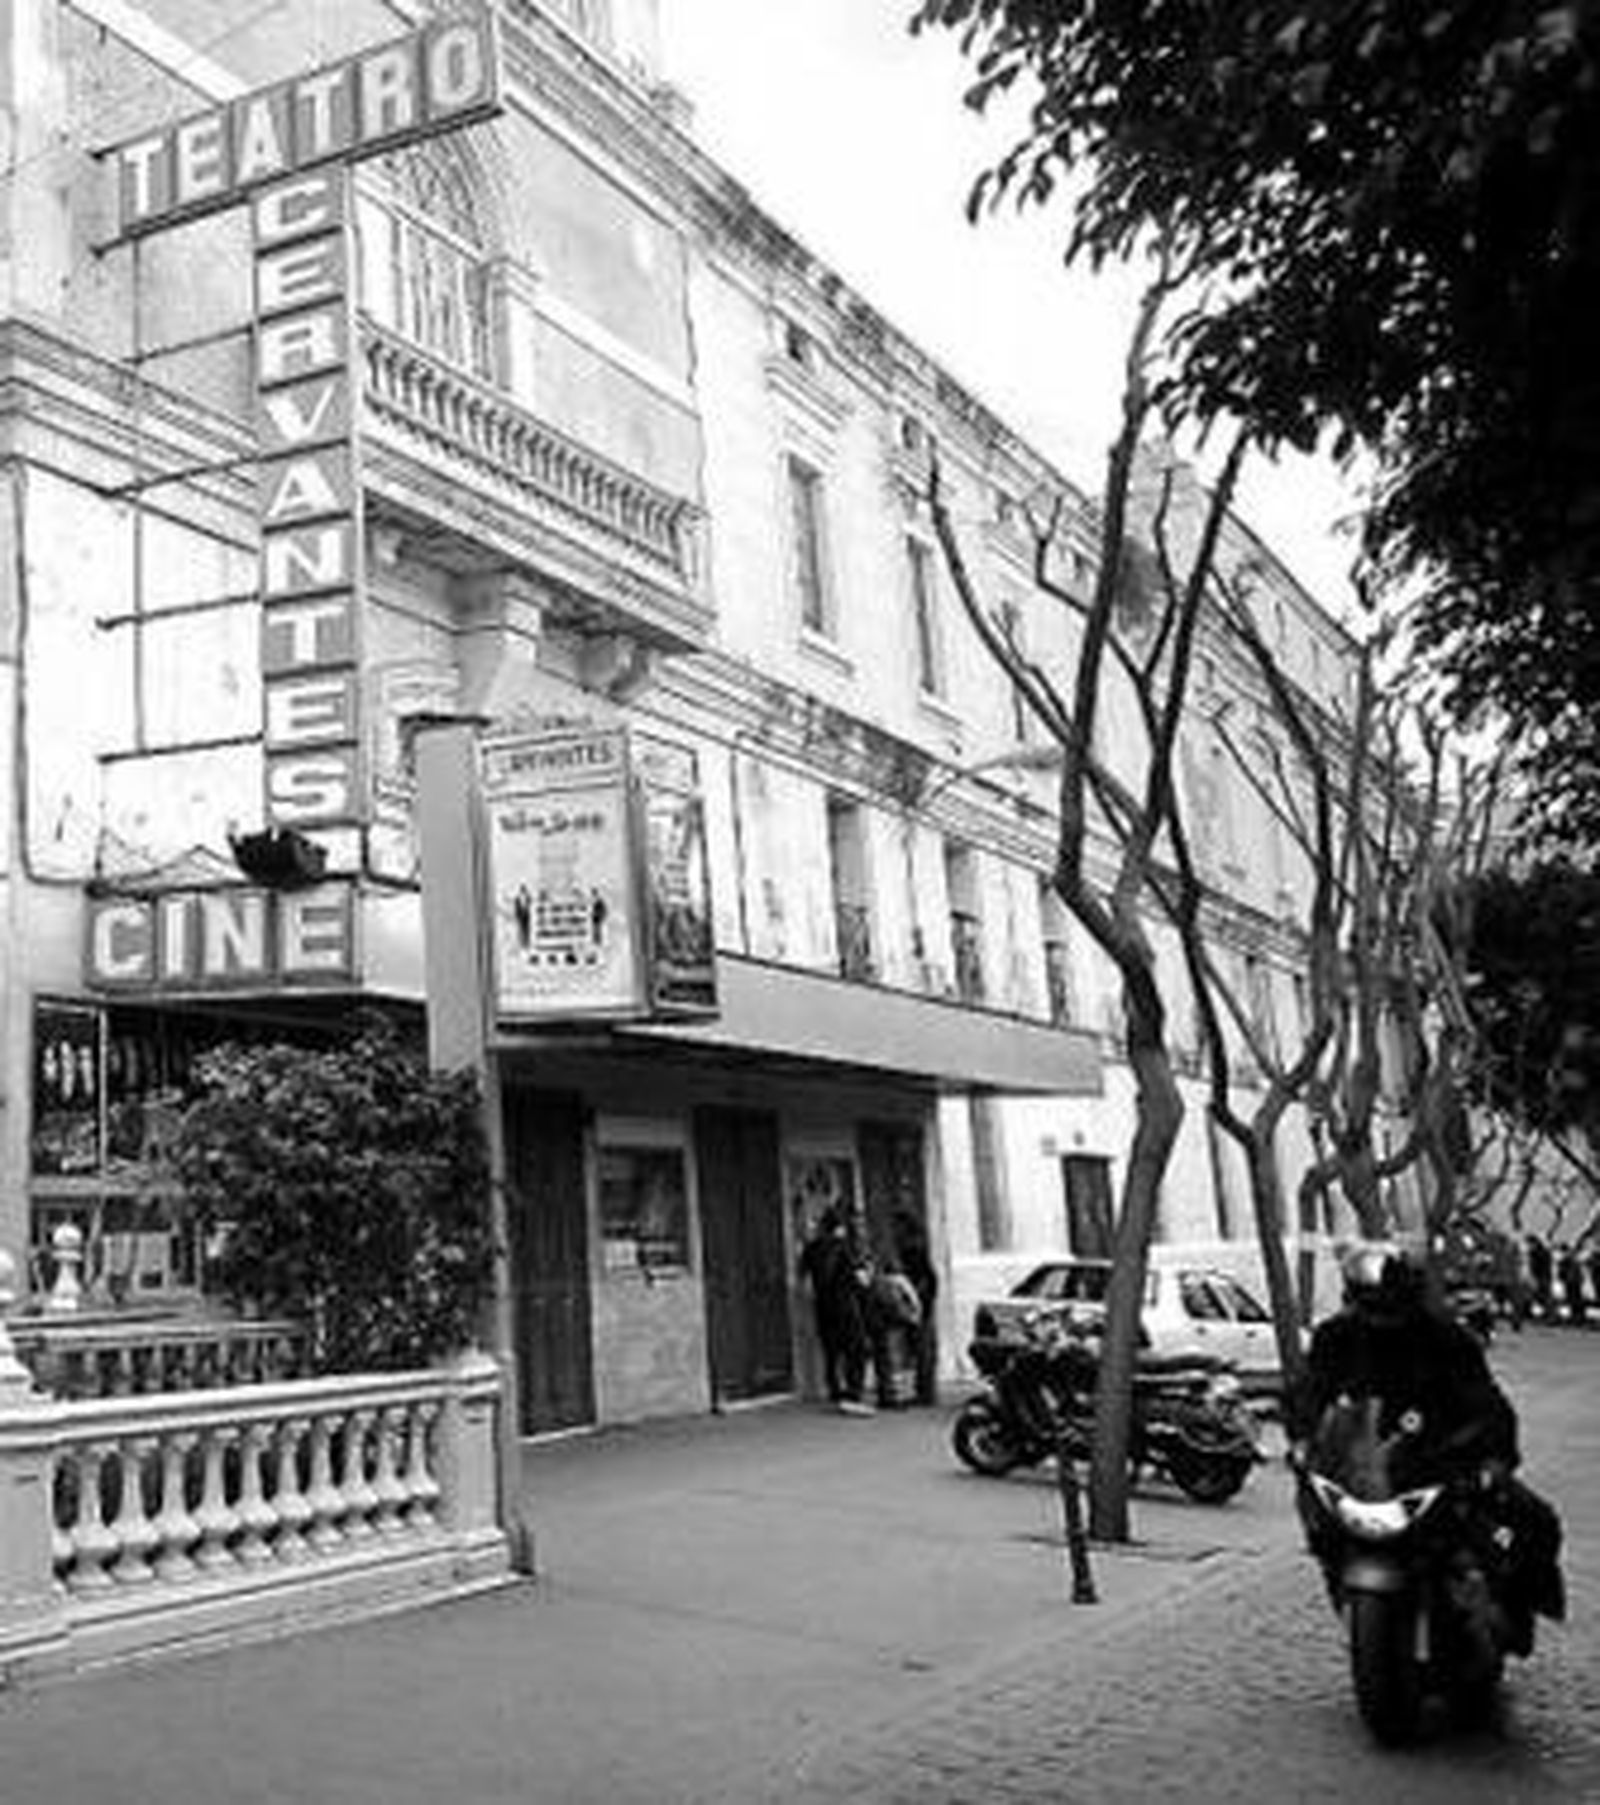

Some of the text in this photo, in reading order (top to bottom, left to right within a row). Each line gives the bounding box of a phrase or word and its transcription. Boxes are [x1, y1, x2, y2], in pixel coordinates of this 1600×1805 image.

[121, 24, 484, 214] TEATRO
[256, 180, 346, 825] CERVANTES
[93, 895, 344, 978] CINE
